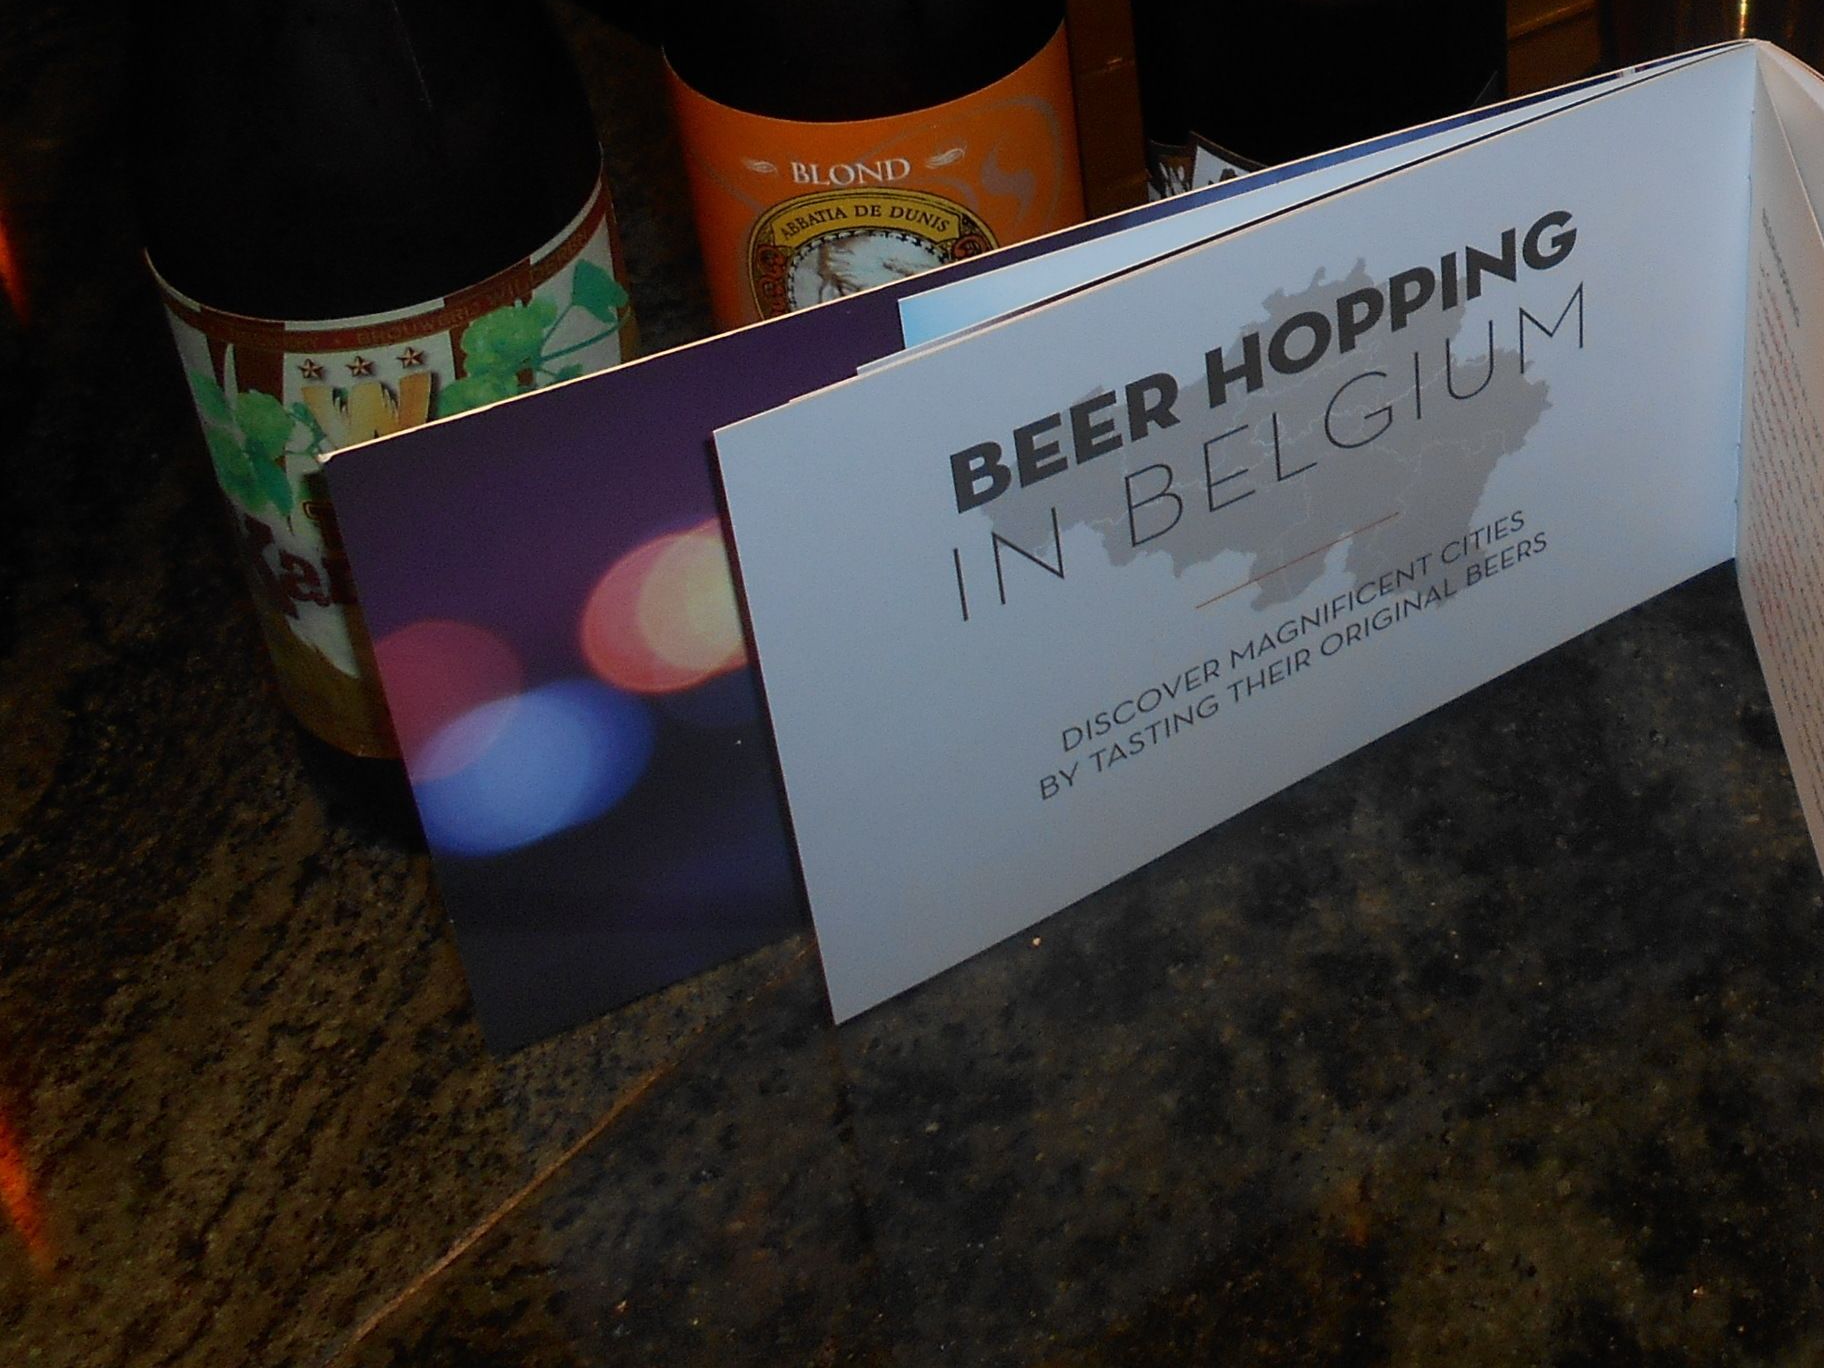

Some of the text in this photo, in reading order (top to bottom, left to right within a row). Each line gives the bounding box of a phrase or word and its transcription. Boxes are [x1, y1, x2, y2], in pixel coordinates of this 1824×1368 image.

[780, 204, 951, 241] ABBATIA DE DUNIS
[790, 158, 911, 185] BLOND
[949, 371, 1180, 514] BEER
[1204, 209, 1579, 409] HOPPING
[951, 505, 1067, 622] IN
[1124, 281, 1586, 549] BELGIUM
[1039, 531, 1549, 802] BY TASTING THEIR ORIGINAL BEERS
[1060, 509, 1527, 754] DISCOVER MAGNIFICENT CITIES
